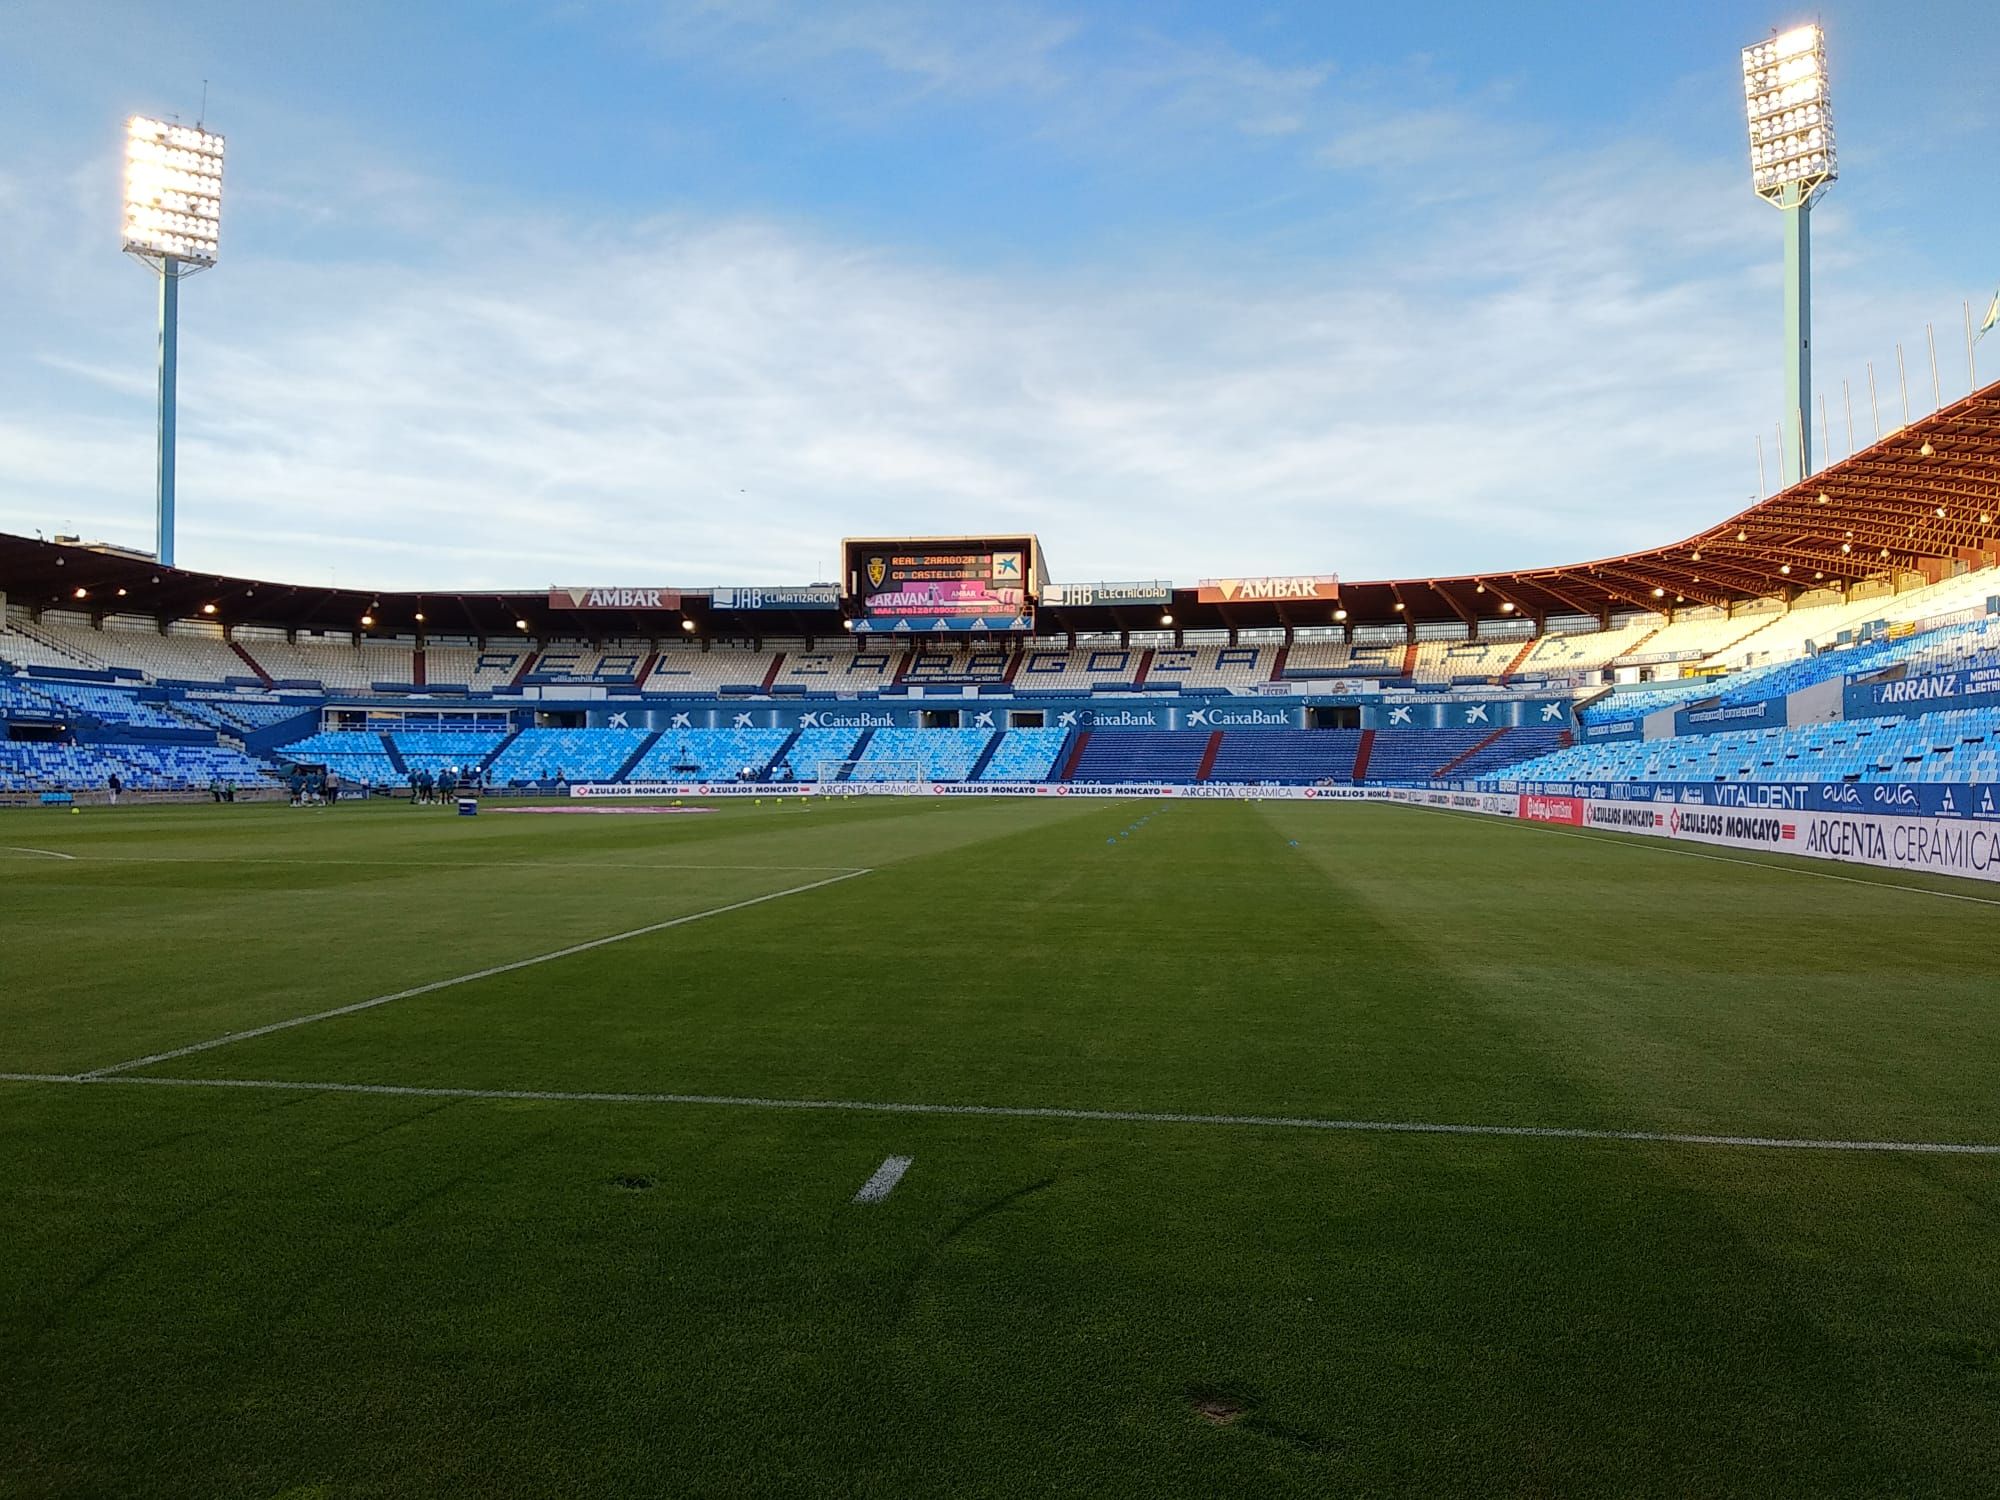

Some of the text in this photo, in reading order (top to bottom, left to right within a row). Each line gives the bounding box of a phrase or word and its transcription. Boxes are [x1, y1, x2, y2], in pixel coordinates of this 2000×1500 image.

[892, 555, 991, 565] REAL ZARAGOZA 0
[892, 570, 991, 579] CD CASTELLON 0
[1064, 584, 1167, 605] JAB ELECTRICIDAD
[1240, 578, 1318, 599] AMBAR
[587, 589, 662, 608] AMBAR
[733, 588, 837, 609] JAB CLIMATIZACIÓN
[873, 606, 983, 614] www.realzaragoza.com
[550, 674, 604, 683] williamhill.es
[1880, 674, 1957, 703] ARRANZ
[1403, 694, 1453, 705] Limpiezas
[1459, 693, 1526, 703] #zaragozateamo
[819, 711, 896, 728] CaixaBank
[1079, 709, 1157, 727] CaixaBank
[1208, 708, 1290, 726] CaixaBank
[709, 786, 753, 794] AZULEJOS
[819, 785, 869, 795] ARGENTA
[944, 786, 1036, 795] AZULEJOS MONCAYO
[1068, 787, 1161, 795] AZULEJOS MONCAYO
[1182, 786, 1293, 798] ARGENTA CERÁMICA
[1316, 790, 1366, 798] AZULEJOS
[1610, 783, 1630, 800] ARTICO
[1714, 784, 1809, 809] VITALDENT
[1822, 784, 1863, 805] aura
[1873, 784, 1920, 807] aura
[1592, 806, 1654, 828] AZULEJOS MONCAYO
[1679, 812, 1781, 842] AZULEJOS MONCAYO
[1805, 818, 2000, 872] ARGENTA CERÁMICA
